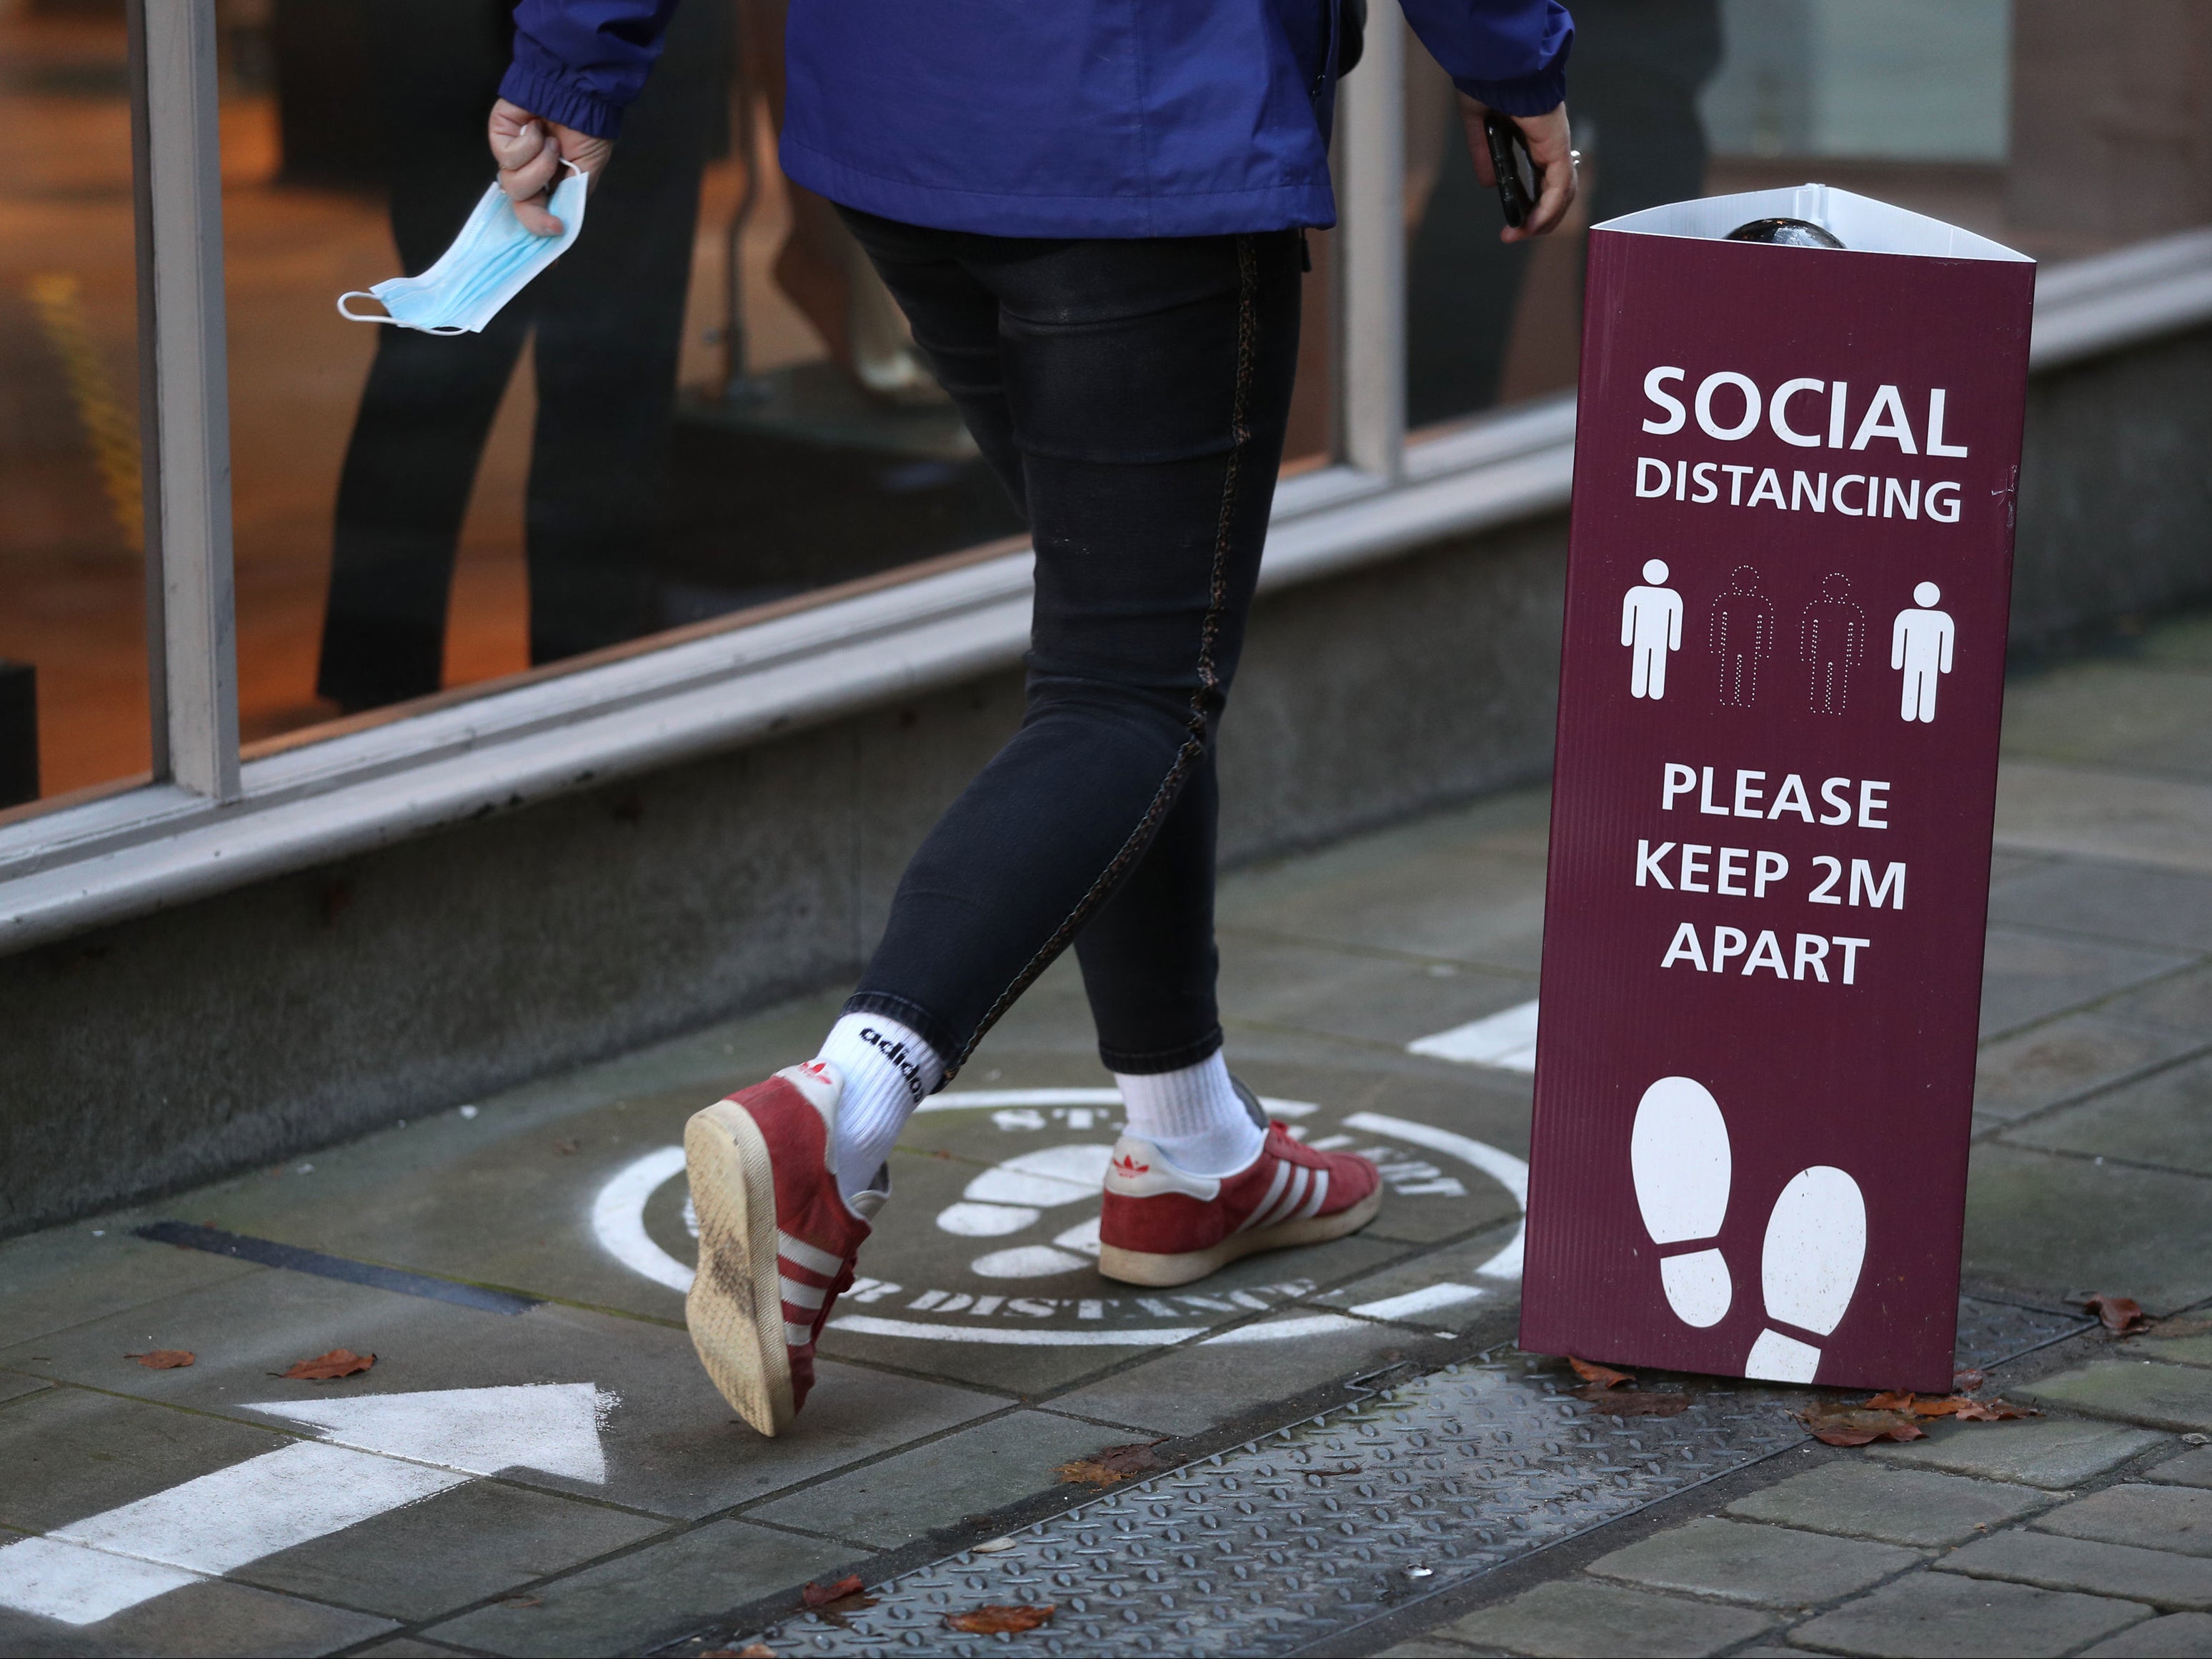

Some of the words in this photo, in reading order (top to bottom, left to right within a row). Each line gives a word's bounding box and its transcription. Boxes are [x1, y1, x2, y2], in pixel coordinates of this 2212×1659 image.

[1643, 367, 1967, 457] SOCIAL
[1636, 457, 1961, 522] DISTANCING
[1663, 763, 1890, 829] PLEASE
[1636, 840, 1788, 897] KEEP
[1809, 856, 1905, 910] 2M
[1661, 923, 1870, 985] APART
